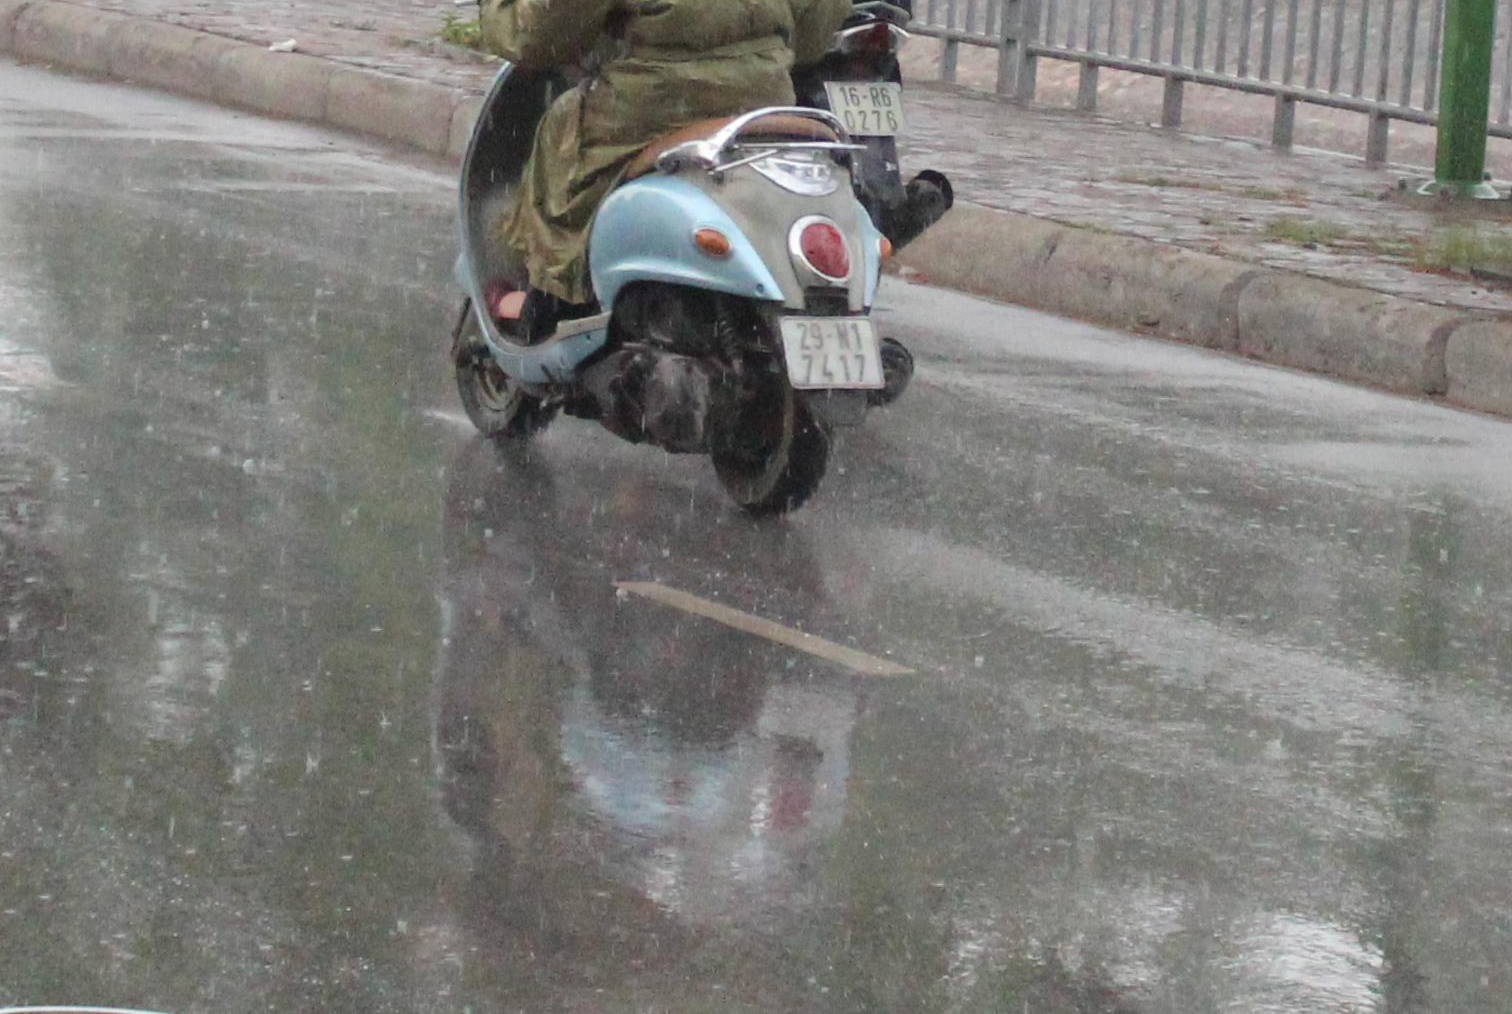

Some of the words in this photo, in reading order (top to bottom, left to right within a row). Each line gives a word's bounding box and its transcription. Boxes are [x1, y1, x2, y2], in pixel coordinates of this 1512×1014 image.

[839, 87, 892, 107] 16-R6
[844, 110, 898, 131] 0276
[796, 322, 862, 350] 29-N1
[801, 354, 866, 383] 7417
